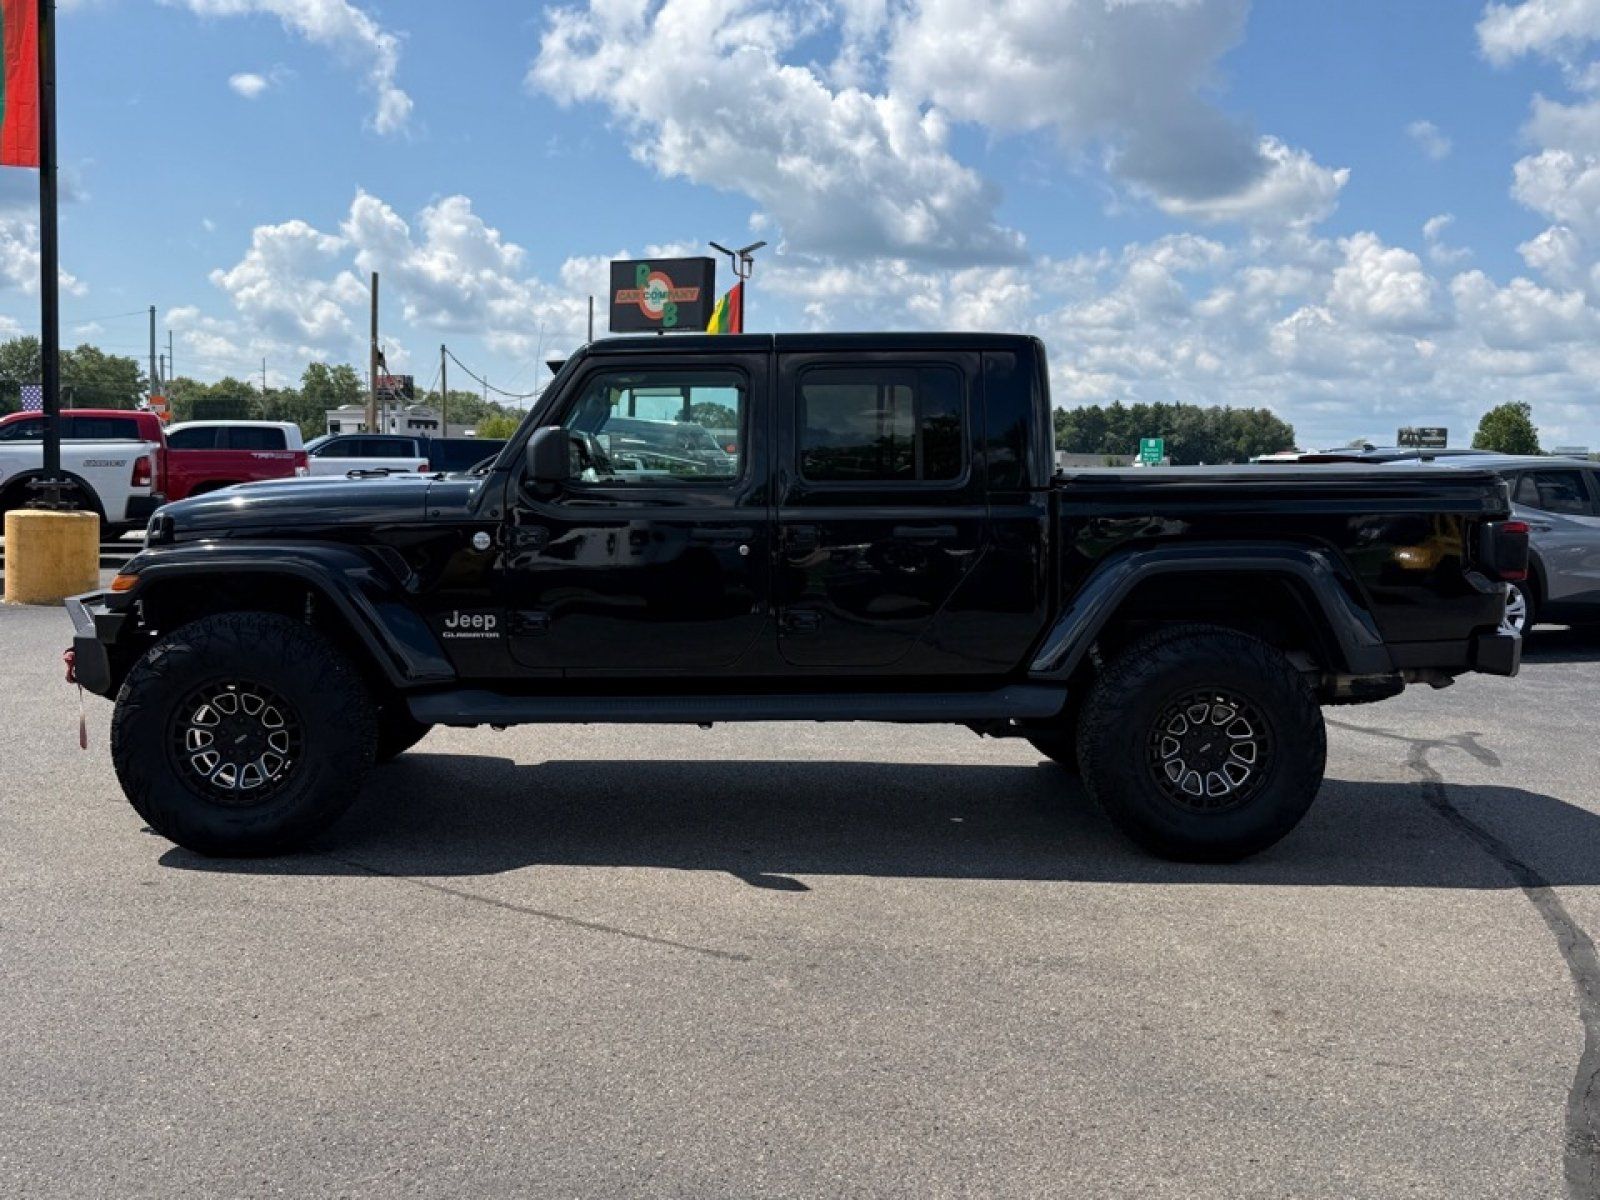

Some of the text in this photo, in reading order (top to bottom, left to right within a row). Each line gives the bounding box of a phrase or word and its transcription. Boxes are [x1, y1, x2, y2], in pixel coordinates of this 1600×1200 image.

[663, 303, 678, 327] B
[444, 610, 496, 631] Jeep
[442, 631, 500, 639] GLADIATOR
